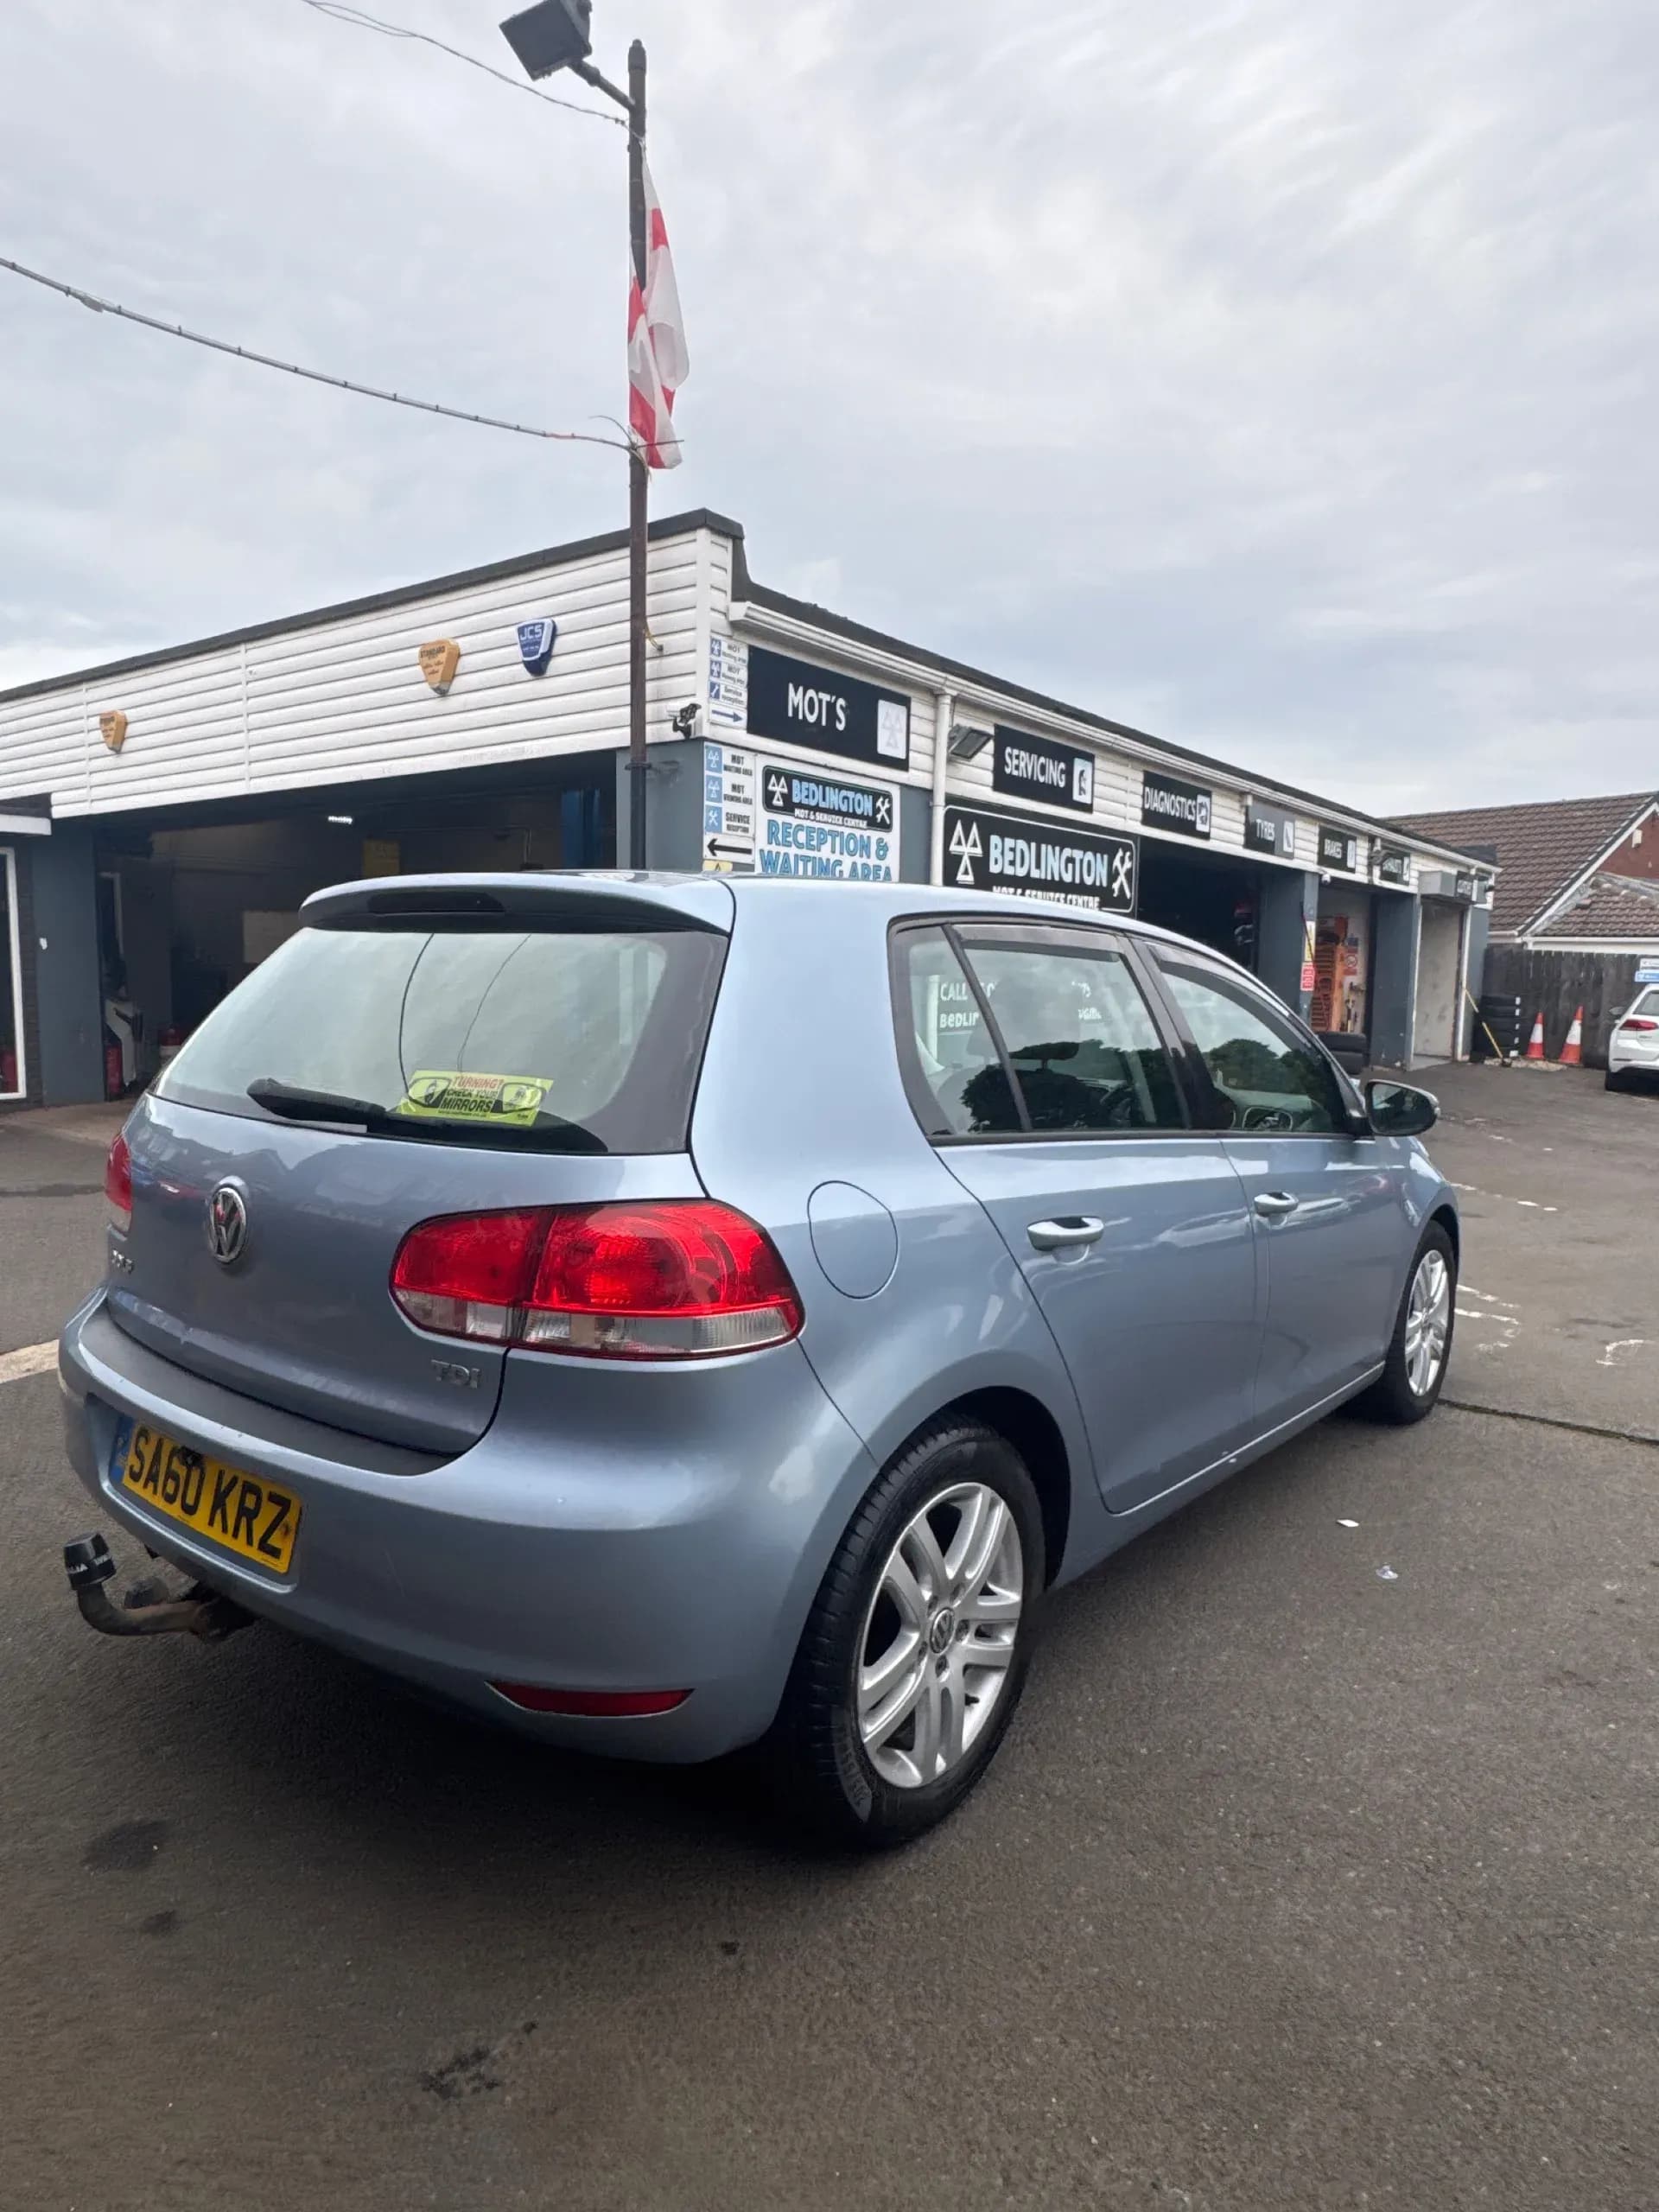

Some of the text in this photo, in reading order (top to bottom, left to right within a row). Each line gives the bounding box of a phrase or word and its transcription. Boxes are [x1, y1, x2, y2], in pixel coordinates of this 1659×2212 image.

[520, 624, 543, 641] JCS
[788, 683, 846, 731] MOT'S
[731, 754, 744, 765] MOT
[1004, 747, 1065, 788] SERVICING
[731, 784, 744, 794] MOT
[791, 779, 873, 817] BEDLINGTON
[1144, 786, 1197, 821] DIAGNOSTICS
[726, 812, 750, 824] SERVICE
[795, 808, 868, 829] MOT & SERVICE CENTRE
[767, 819, 889, 861] RECEPTION &
[1255, 819, 1274, 842] TYRES
[760, 849, 892, 881] WAITING AREA
[989, 835, 1108, 887] BEDLINGTON
[1067, 894, 1100, 910] CENTRE
[940, 982, 968, 1001] CALL
[441, 1096, 494, 1113] MIRRORS
[447, 1088, 499, 1099] CHECK YOUR
[431, 1359, 480, 1389] TDI
[129, 1427, 292, 1560] SA60 KRZ
